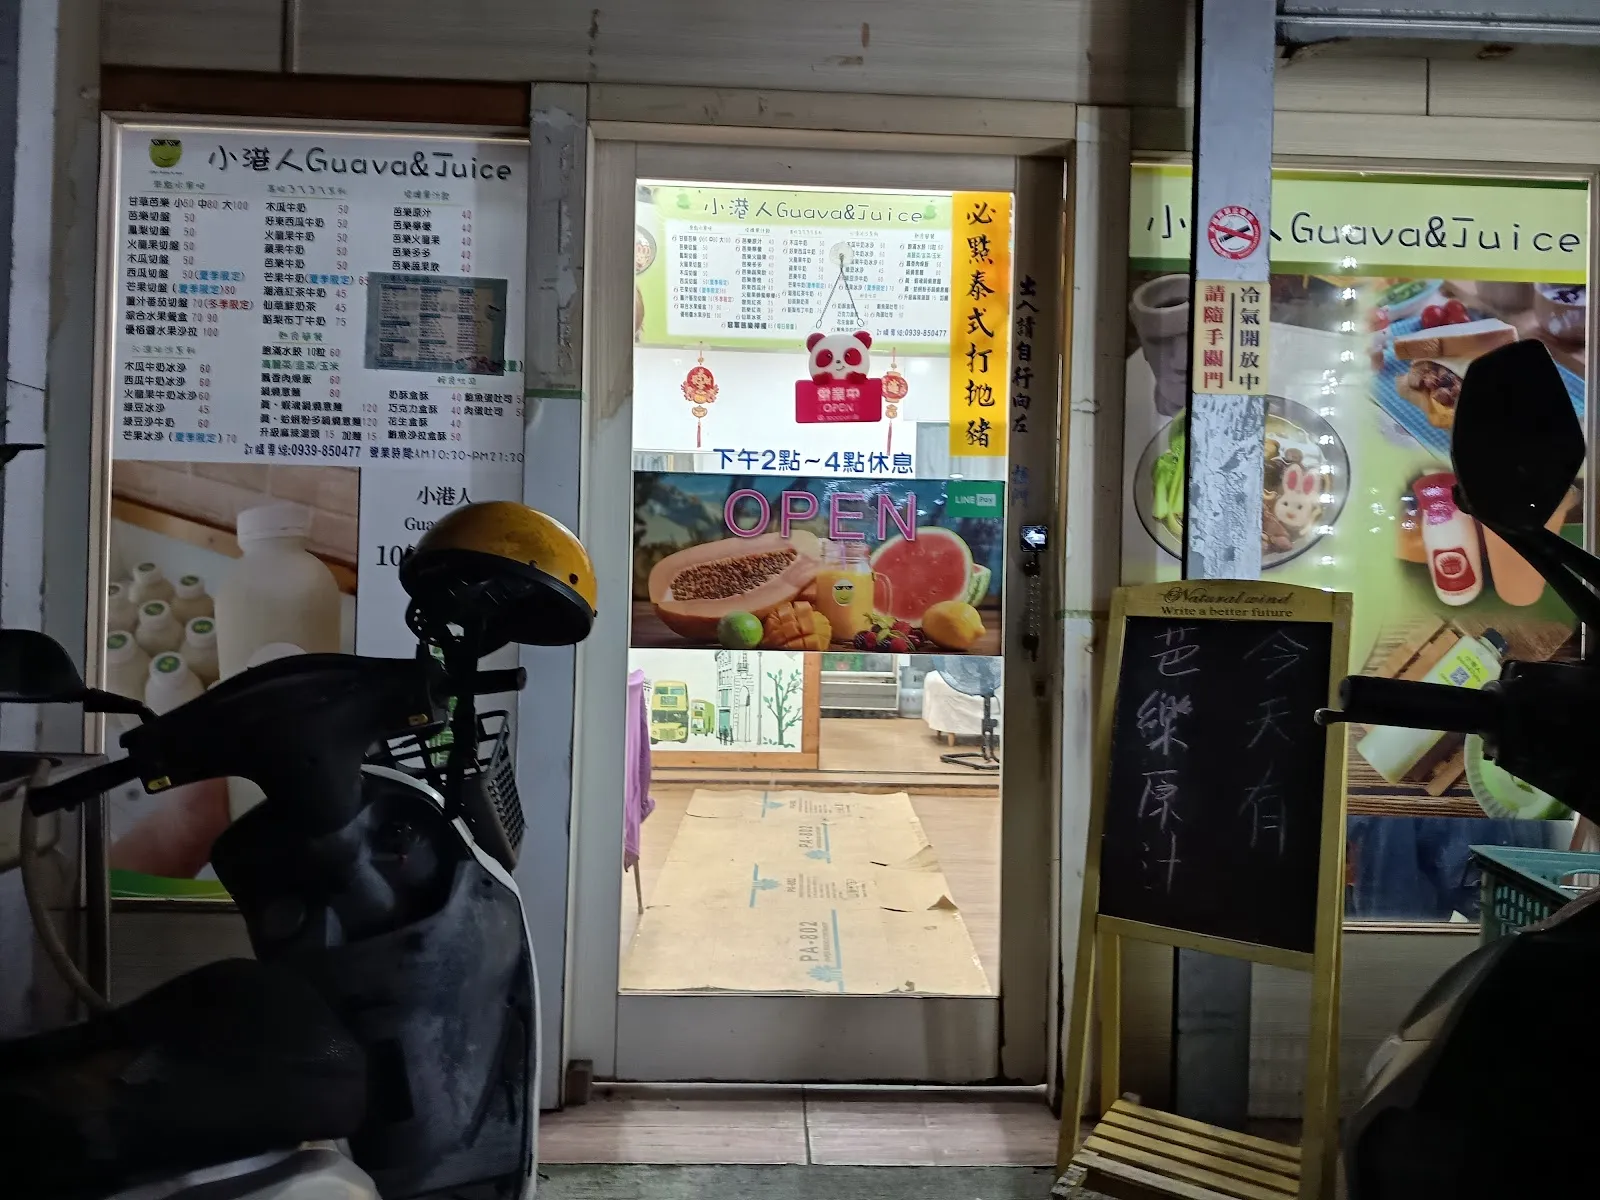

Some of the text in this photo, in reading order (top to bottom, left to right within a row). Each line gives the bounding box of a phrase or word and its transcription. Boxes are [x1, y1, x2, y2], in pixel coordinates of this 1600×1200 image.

[208, 145, 512, 181] 小港人Guava&Juice
[265, 202, 306, 213] 木瓜牛奶
[393, 206, 432, 217] 芭樂原汁
[704, 197, 924, 223] 小港人Guava&Juice
[127, 253, 169, 265] 木瓜切盤
[126, 267, 169, 279] 西瓜切盤
[1203, 285, 1224, 390] 請隨手關門
[1239, 285, 1261, 391] 冷氣開放中
[1012, 273, 1040, 434] 出入請自行向左
[124, 361, 187, 373] 木瓜牛奶冰沙
[124, 375, 186, 387] 西瓜牛奶冰沙
[823, 403, 854, 413] OPEN
[122, 430, 164, 441] 芒果冰沙
[416, 485, 473, 506] 小港人
[955, 495, 976, 504] LINE
[723, 488, 917, 542] OPEN
[1245, 591, 1294, 605] wind
[1161, 605, 1294, 618] Write a better future
[1238, 629, 1309, 857] 今天有
